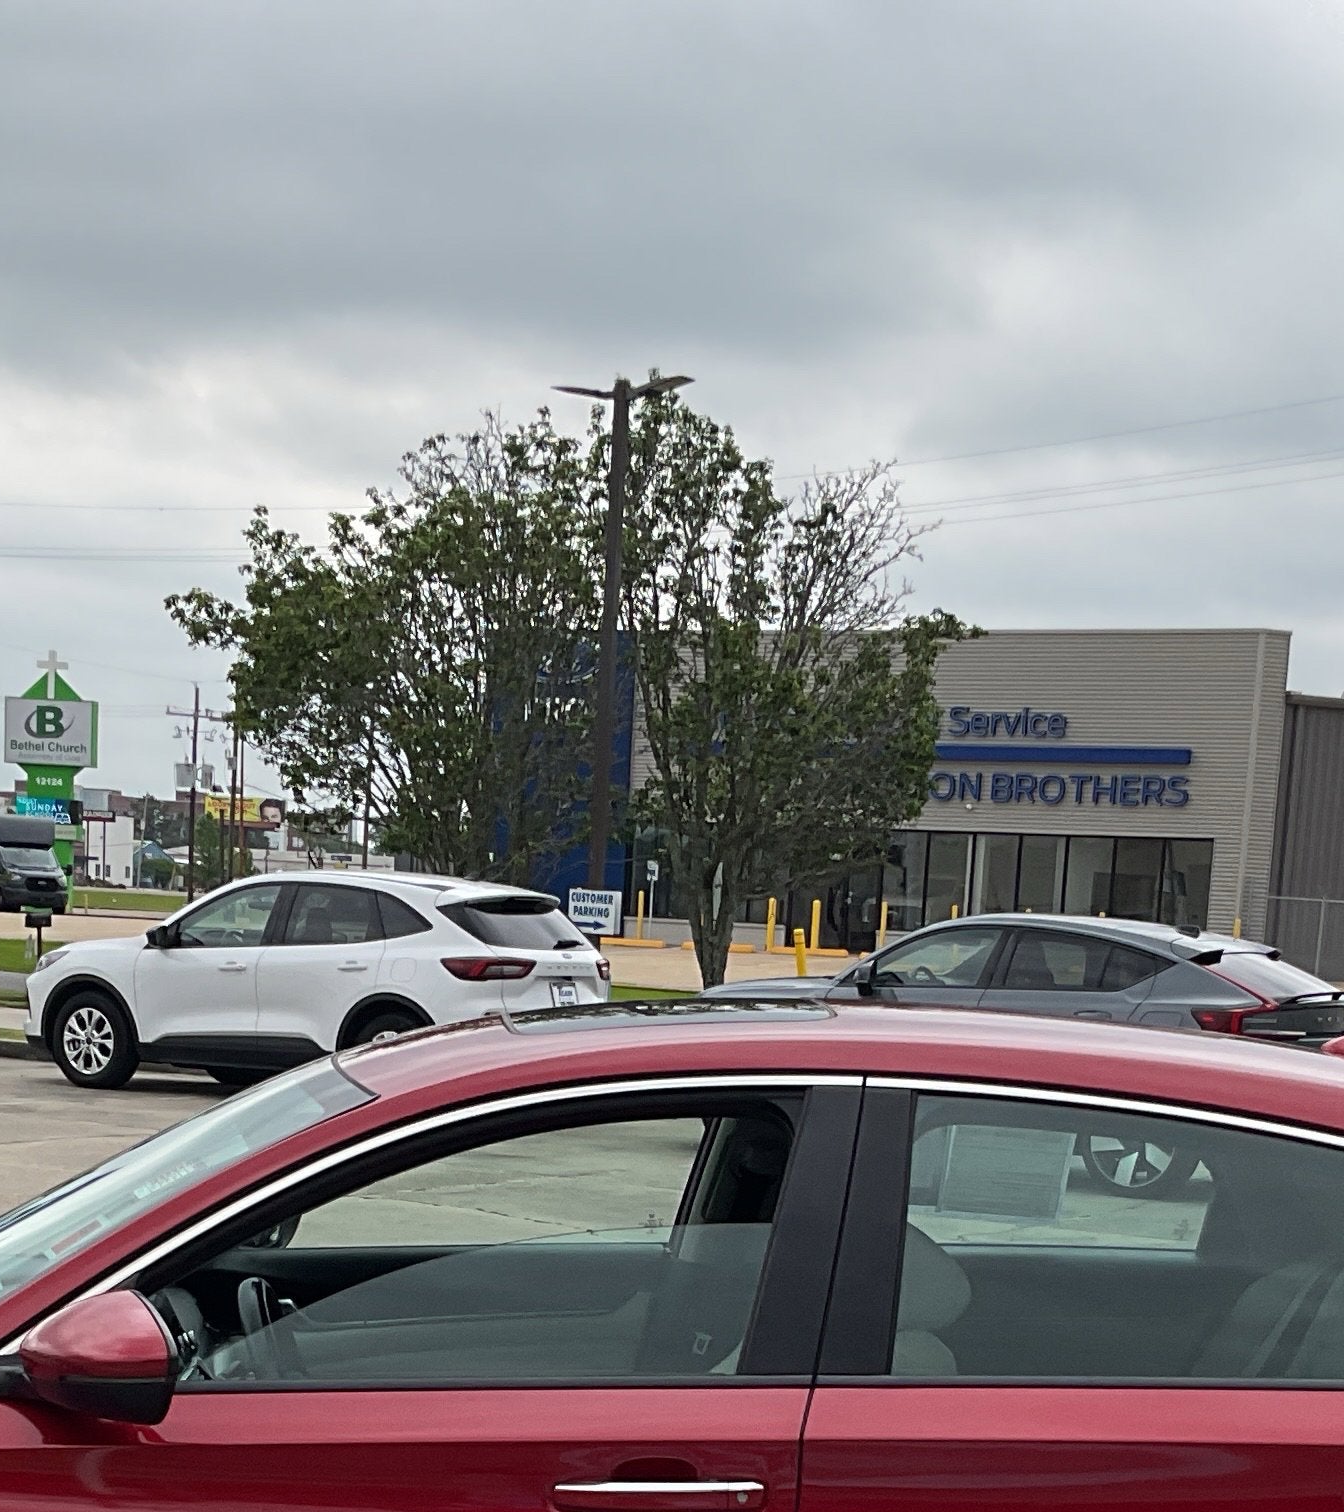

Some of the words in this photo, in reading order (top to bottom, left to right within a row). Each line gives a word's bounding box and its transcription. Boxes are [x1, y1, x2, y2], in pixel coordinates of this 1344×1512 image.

[36, 705, 65, 739] B
[948, 706, 1068, 738] Service
[10, 739, 45, 752] Bethel
[47, 741, 87, 754] Church
[990, 772, 1190, 807] BROTHERS
[571, 891, 614, 906] CUSTOMER
[573, 905, 610, 919] PARKING
